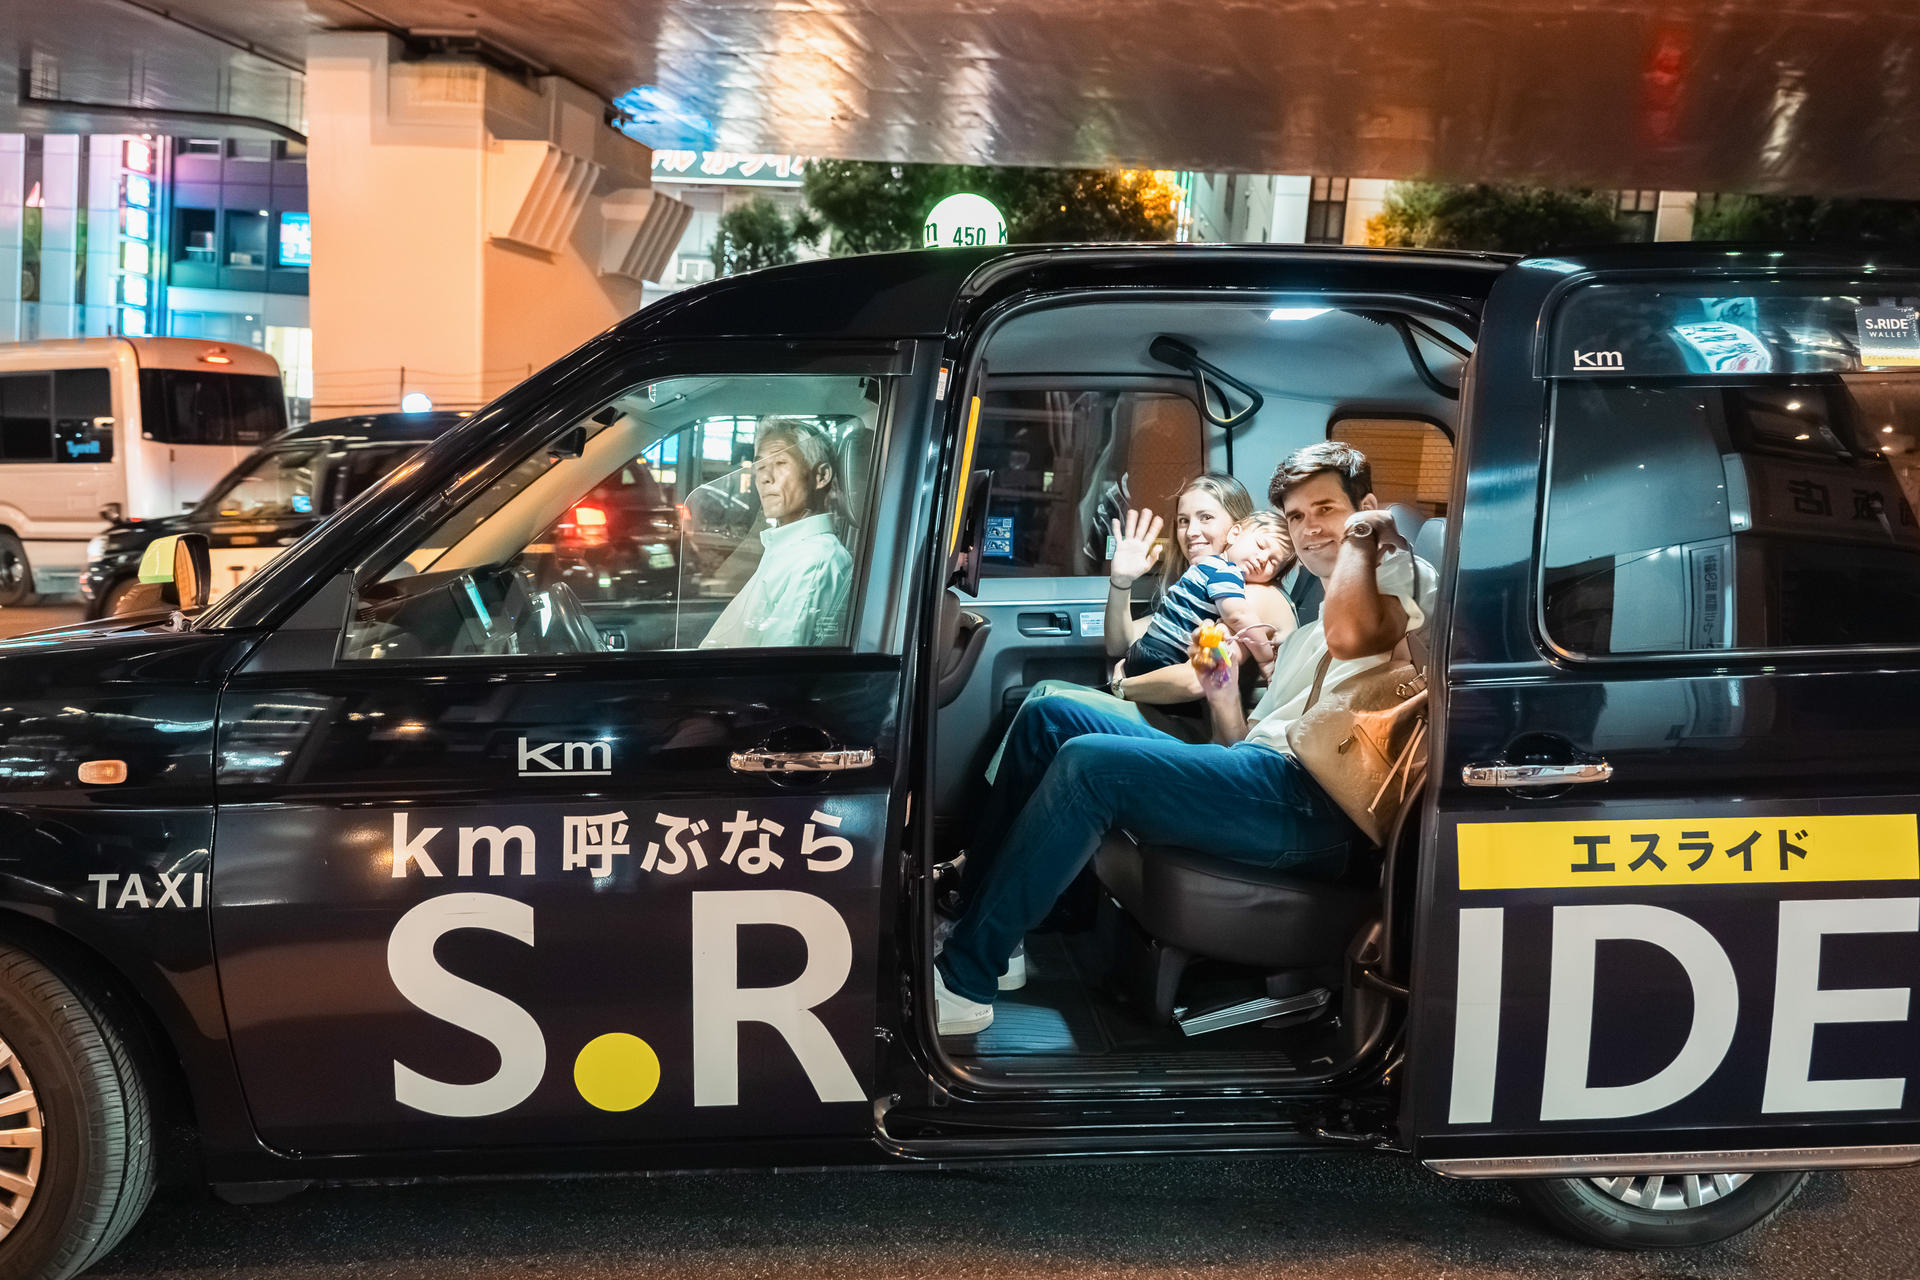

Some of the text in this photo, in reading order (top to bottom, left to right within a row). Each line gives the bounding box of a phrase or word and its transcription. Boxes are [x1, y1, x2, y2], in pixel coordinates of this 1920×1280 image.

[952, 226, 986, 246] 450
[1864, 318, 1910, 330] S.RIDE
[1868, 331, 1909, 339] WALLET
[1572, 349, 1625, 371] km
[518, 735, 613, 777] km
[391, 809, 855, 880] km 呼ぶなら
[1570, 829, 1809, 873] エスライド
[88, 872, 204, 910] TAXI
